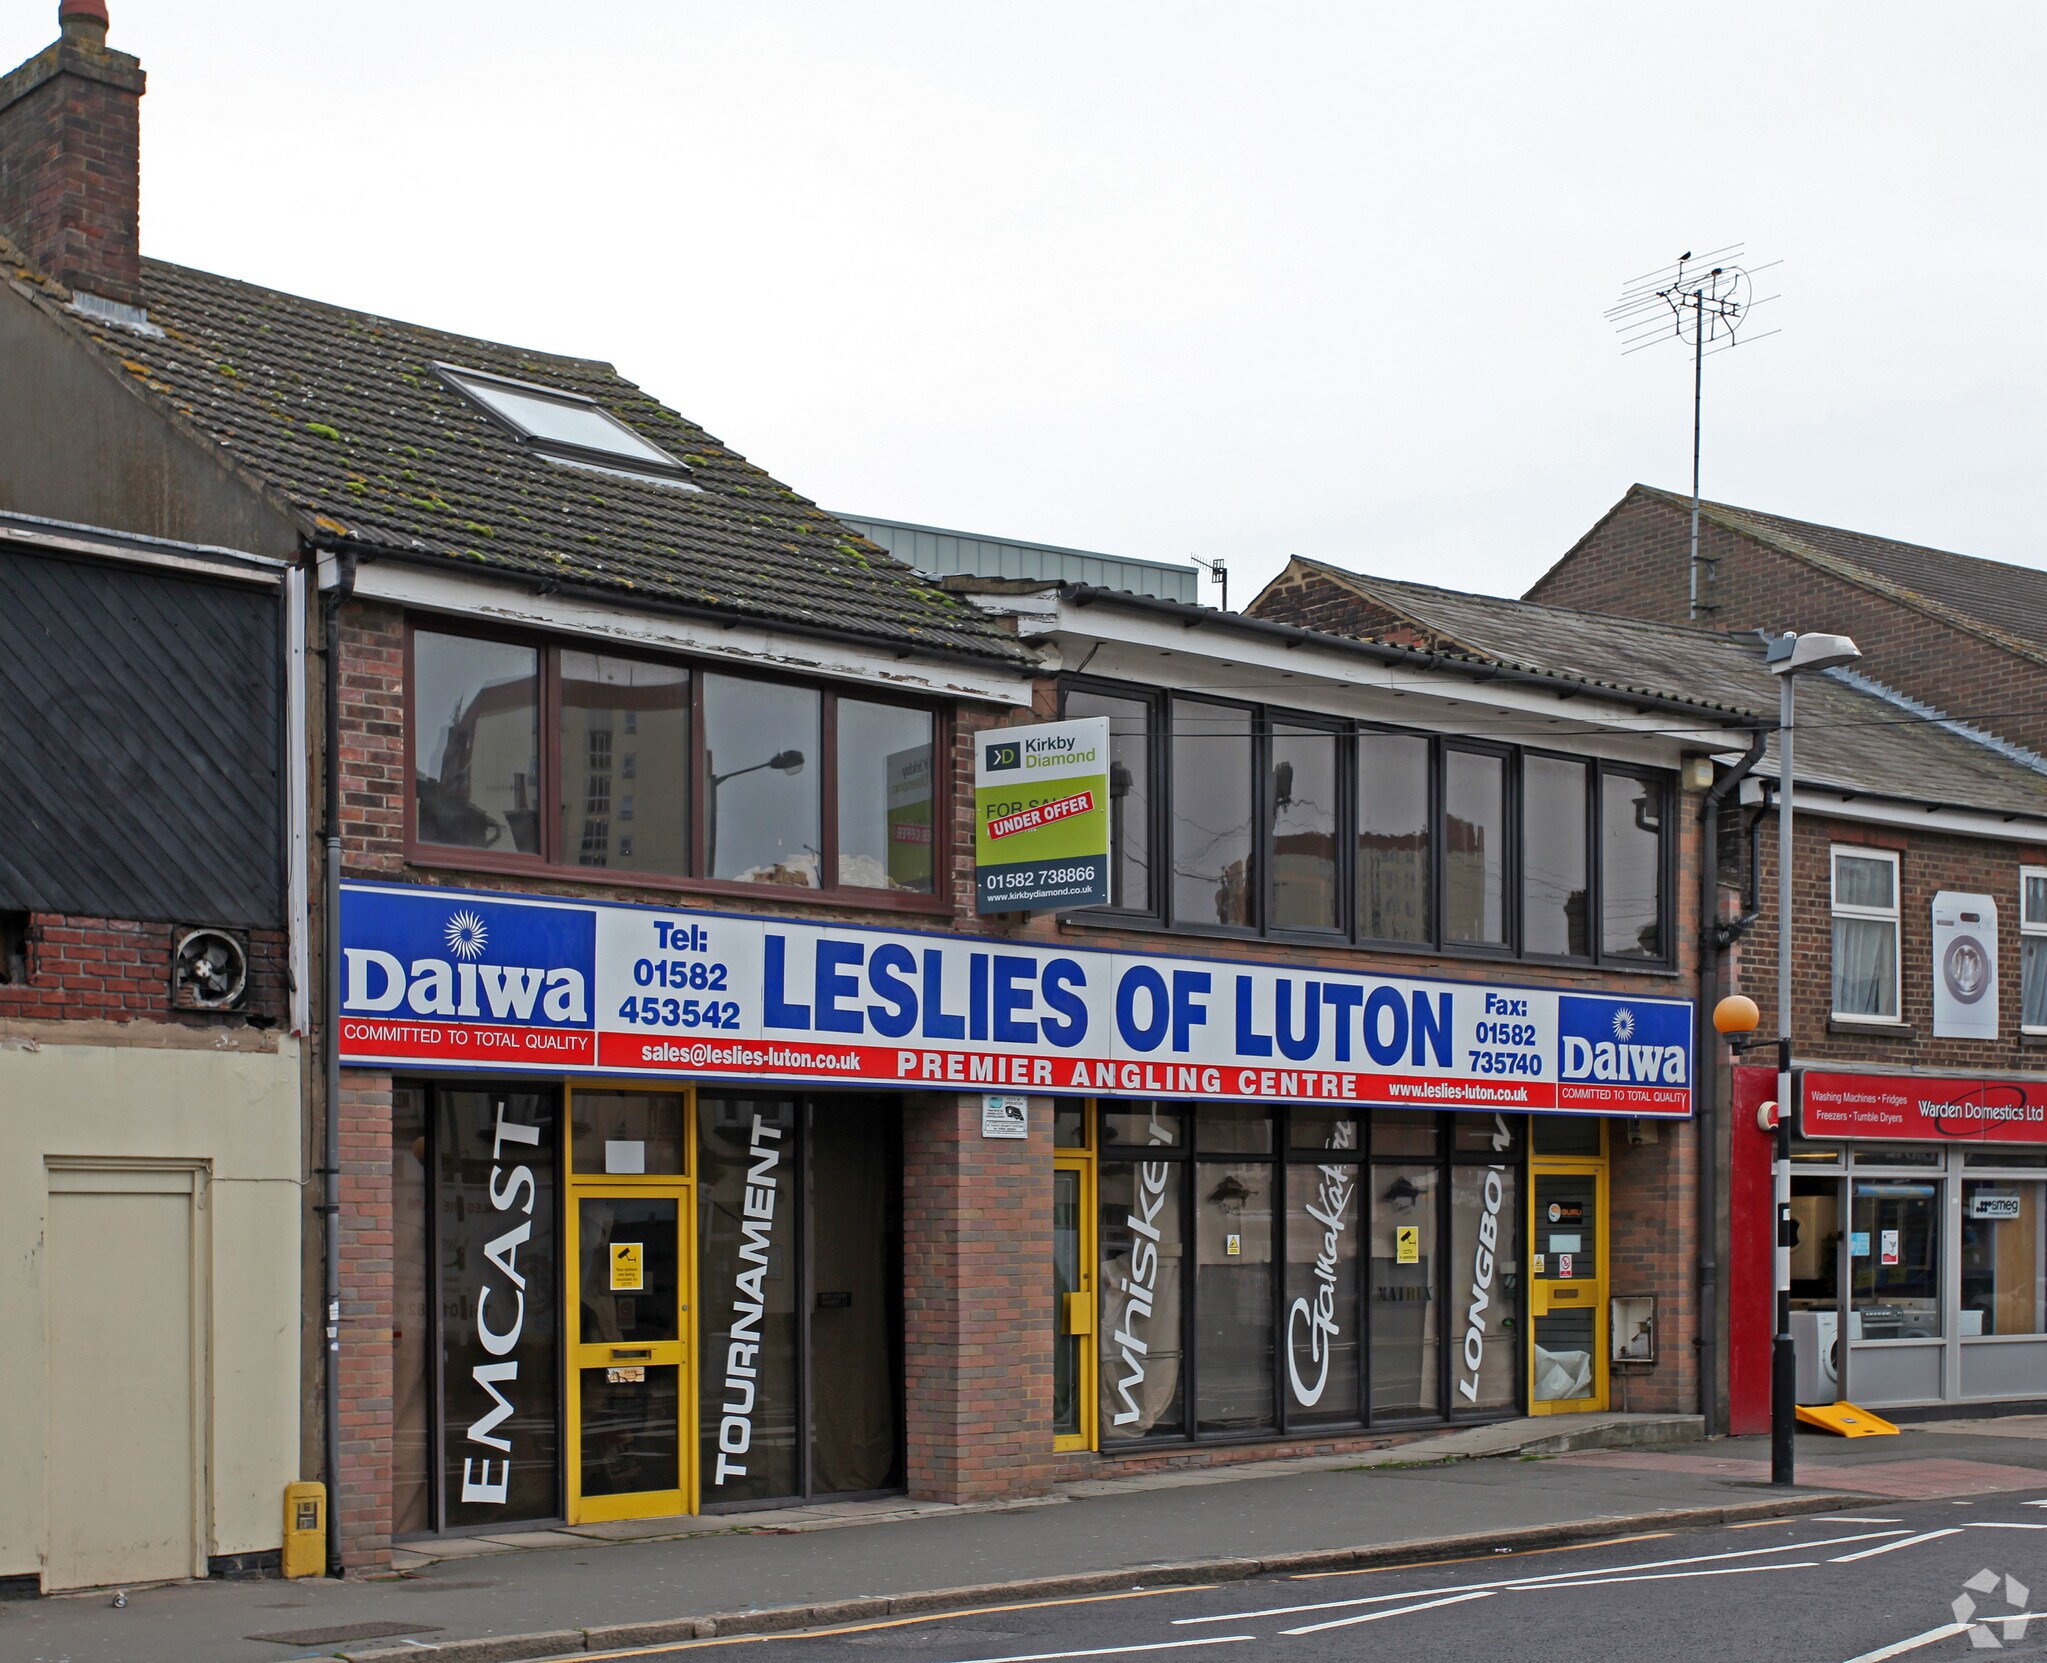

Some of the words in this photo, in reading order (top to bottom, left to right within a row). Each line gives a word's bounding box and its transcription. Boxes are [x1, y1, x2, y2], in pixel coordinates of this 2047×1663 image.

[1025, 736, 1075, 752] Kirkby
[1025, 748, 1096, 768] Diamond
[986, 801, 1022, 819] FOR
[993, 810, 1041, 835] UNDER
[1044, 796, 1088, 820] OFFER
[987, 871, 1034, 889] 01582
[1038, 866, 1095, 884] 738866
[987, 885, 1092, 902] www.kirkbydiamond.co.uk
[653, 921, 707, 952] Tel:
[344, 947, 587, 1022] Daiwa
[633, 958, 728, 991] 01582
[618, 996, 740, 1029] 453542
[764, 934, 1088, 1048] LESLIES
[1116, 965, 1211, 1052] OF
[1235, 975, 1453, 1068] LUTON
[1485, 993, 1527, 1016] Fax:
[344, 1024, 442, 1043] COMMITTED
[447, 1030, 468, 1045] TO
[474, 1031, 520, 1047] TOTAL
[525, 1034, 588, 1050] QUALITY
[1476, 1022, 1536, 1046] 01582
[641, 1042, 861, 1070] sales@leslies-luton.co.uk
[1468, 1050, 1542, 1076] 735740
[1561, 1036, 1686, 1083] Daiwa
[897, 1051, 1053, 1086] PREMIER
[1070, 1060, 1221, 1093] ANGLING
[1238, 1070, 1357, 1098] CENTRE
[1389, 1081, 1528, 1102] www.leslies-luton.co.uk
[1562, 1087, 1611, 1100] COMMITTED
[1612, 1090, 1624, 1101] TO
[1627, 1090, 1651, 1102] TOTAL
[1653, 1092, 1687, 1104] QUALITY
[1811, 1091, 1841, 1104] Washing
[1843, 1092, 1876, 1104] Machines
[1881, 1094, 1907, 1106] Fridges
[1816, 1110, 1847, 1121] Freezers
[1853, 1111, 1878, 1122] Tumble
[1880, 1112, 1903, 1124] Dryers
[1918, 1100, 1962, 1118] Warden
[1965, 1102, 2024, 1121] Domestics
[2026, 1105, 2044, 1121] Ltd
[1991, 1200, 2018, 1214] smeg
[461, 1101, 540, 1504] EMCAST
[714, 1114, 782, 1485] TOURNAMENT
